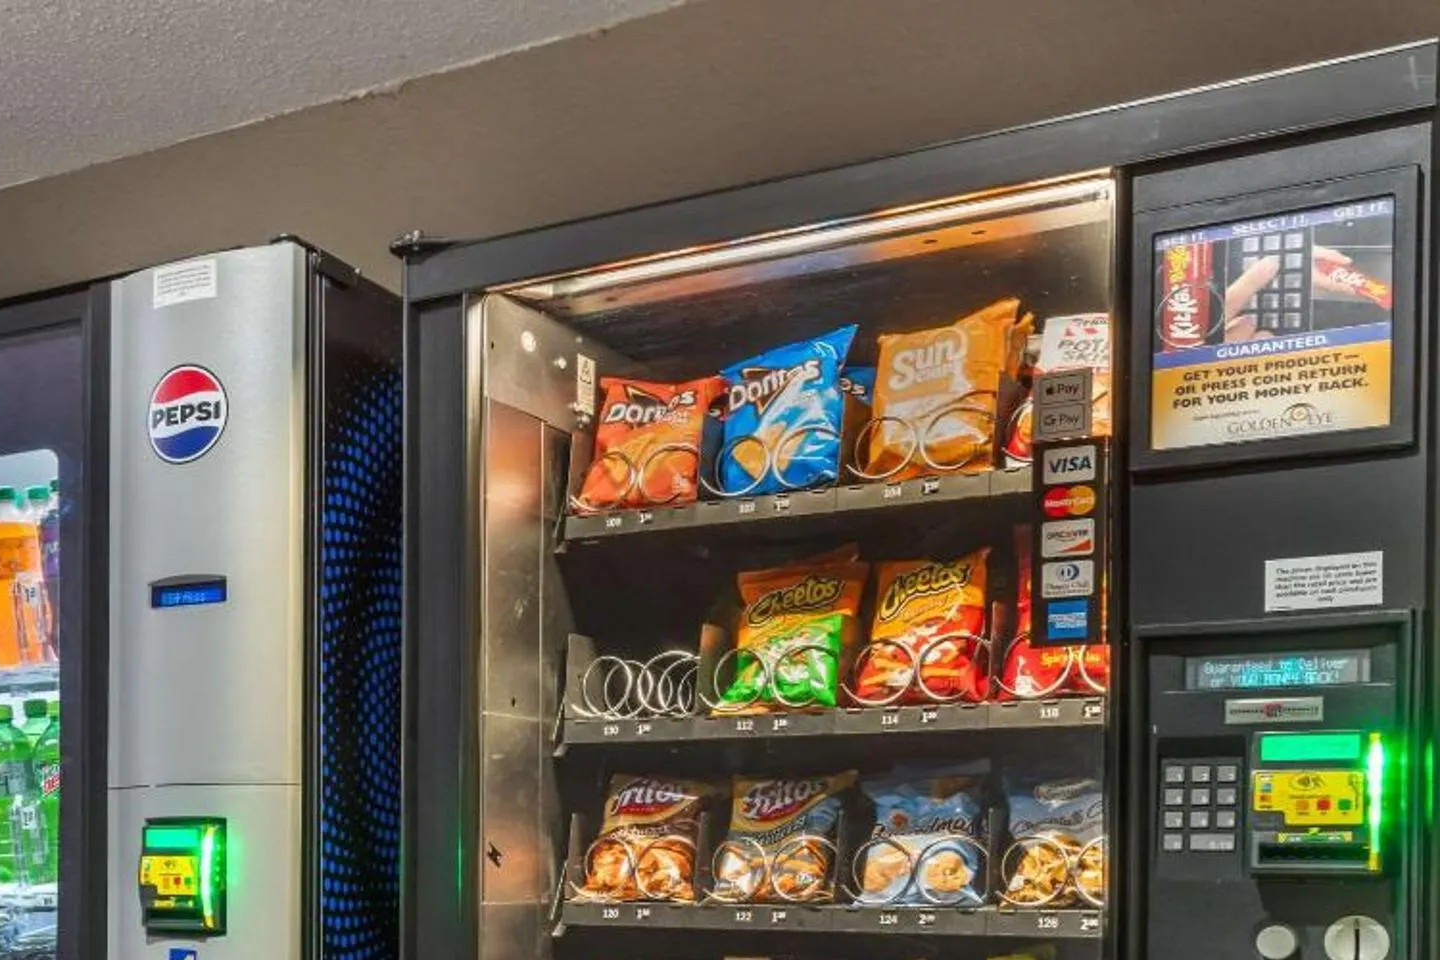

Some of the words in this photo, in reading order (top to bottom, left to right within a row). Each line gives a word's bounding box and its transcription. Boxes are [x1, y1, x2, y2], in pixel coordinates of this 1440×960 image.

[729, 360, 820, 411] Doritos
[1175, 384, 1197, 396] OR
[1202, 378, 1246, 393] PRESS
[1252, 373, 1292, 387] COIN
[1298, 363, 1367, 381] RETURN
[1184, 370, 1210, 382] GET
[1216, 363, 1260, 377] YOUR
[1173, 396, 1202, 409] FOR
[1207, 390, 1249, 404] YOUR
[1255, 383, 1312, 399] MONEY
[152, 401, 221, 429] PEPSI
[1049, 456, 1092, 473] VISA
[748, 577, 841, 626] Cheetos
[881, 564, 971, 620] Cheetos
